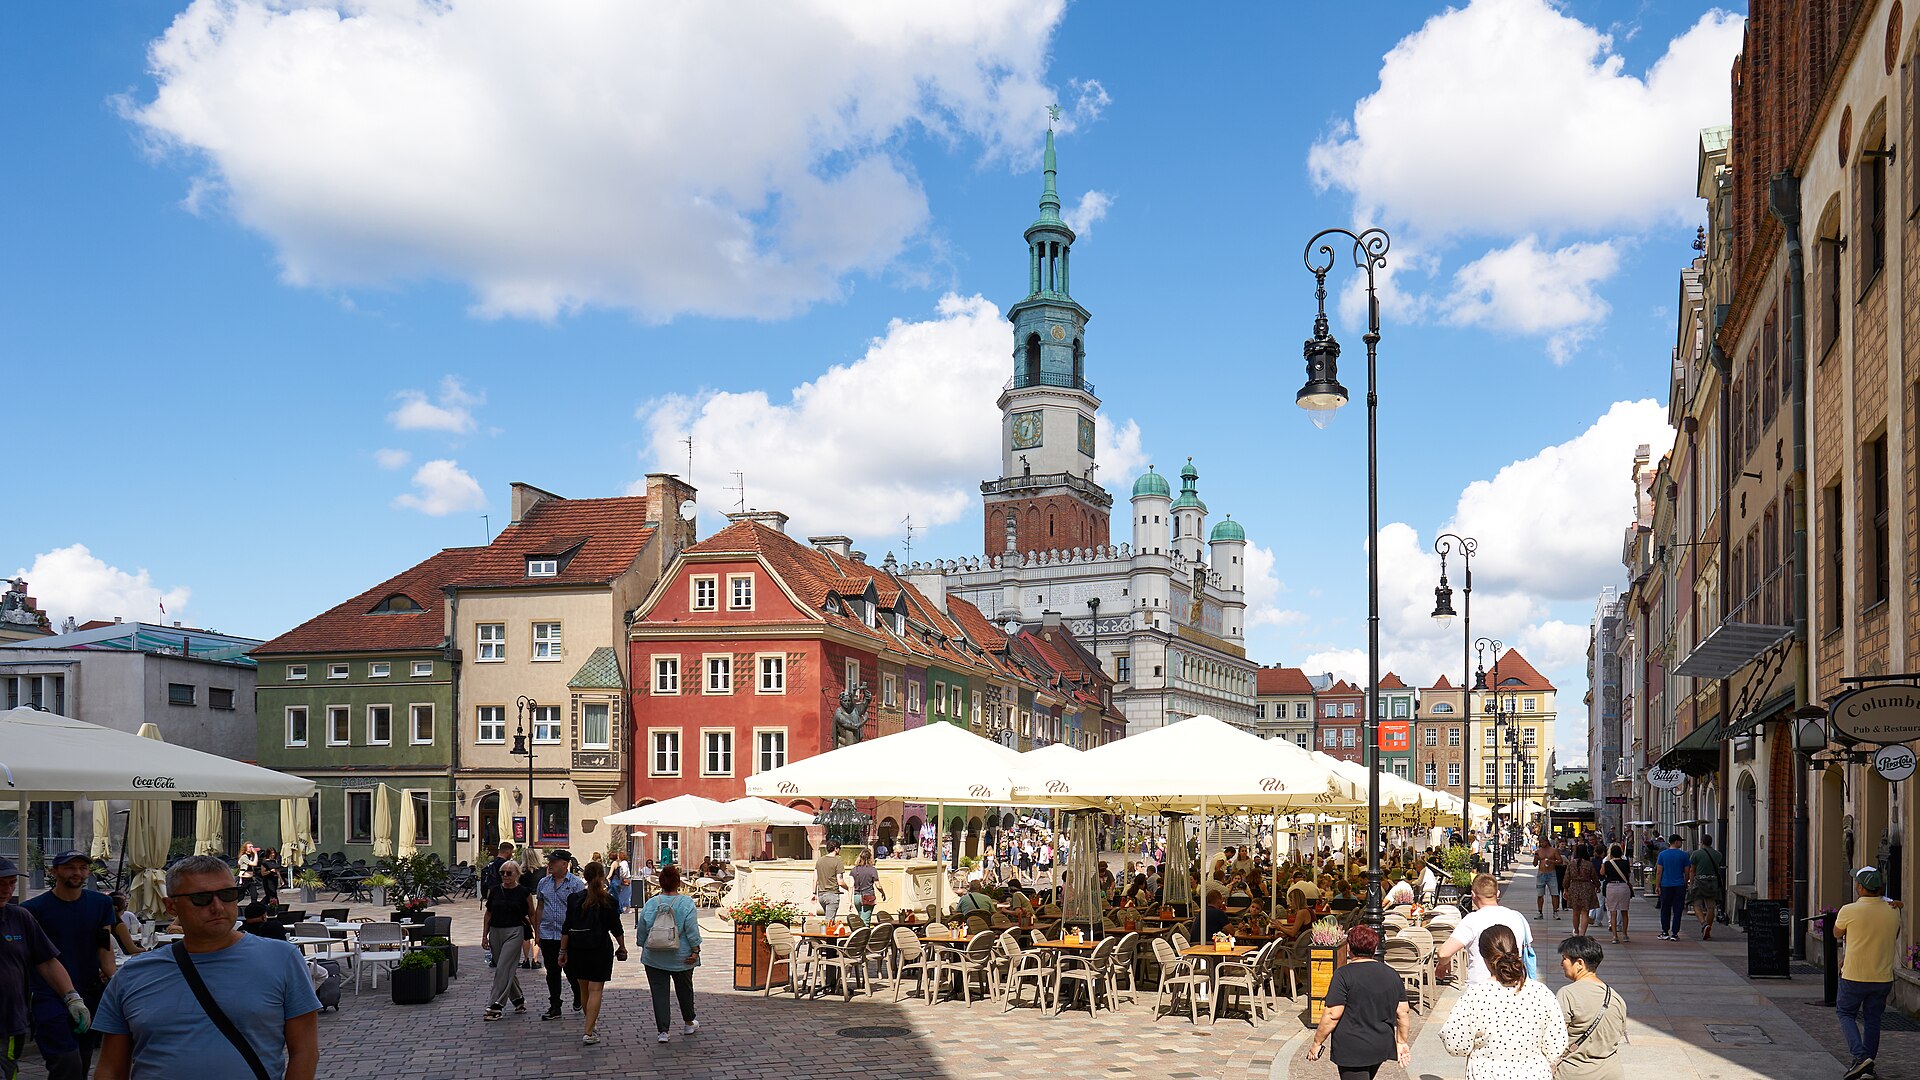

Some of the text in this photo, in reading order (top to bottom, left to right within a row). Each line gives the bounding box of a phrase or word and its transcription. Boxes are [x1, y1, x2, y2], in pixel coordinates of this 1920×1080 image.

[1853, 726, 1870, 734] Pub
[1872, 725, 1881, 733] &
[132, 775, 176, 789] Coca-Cola
[1652, 769, 1680, 783] Billy's
[777, 780, 800, 794] Pils
[968, 784, 992, 797] Pils
[1045, 779, 1071, 793] Pils
[1258, 777, 1287, 792] Pils
